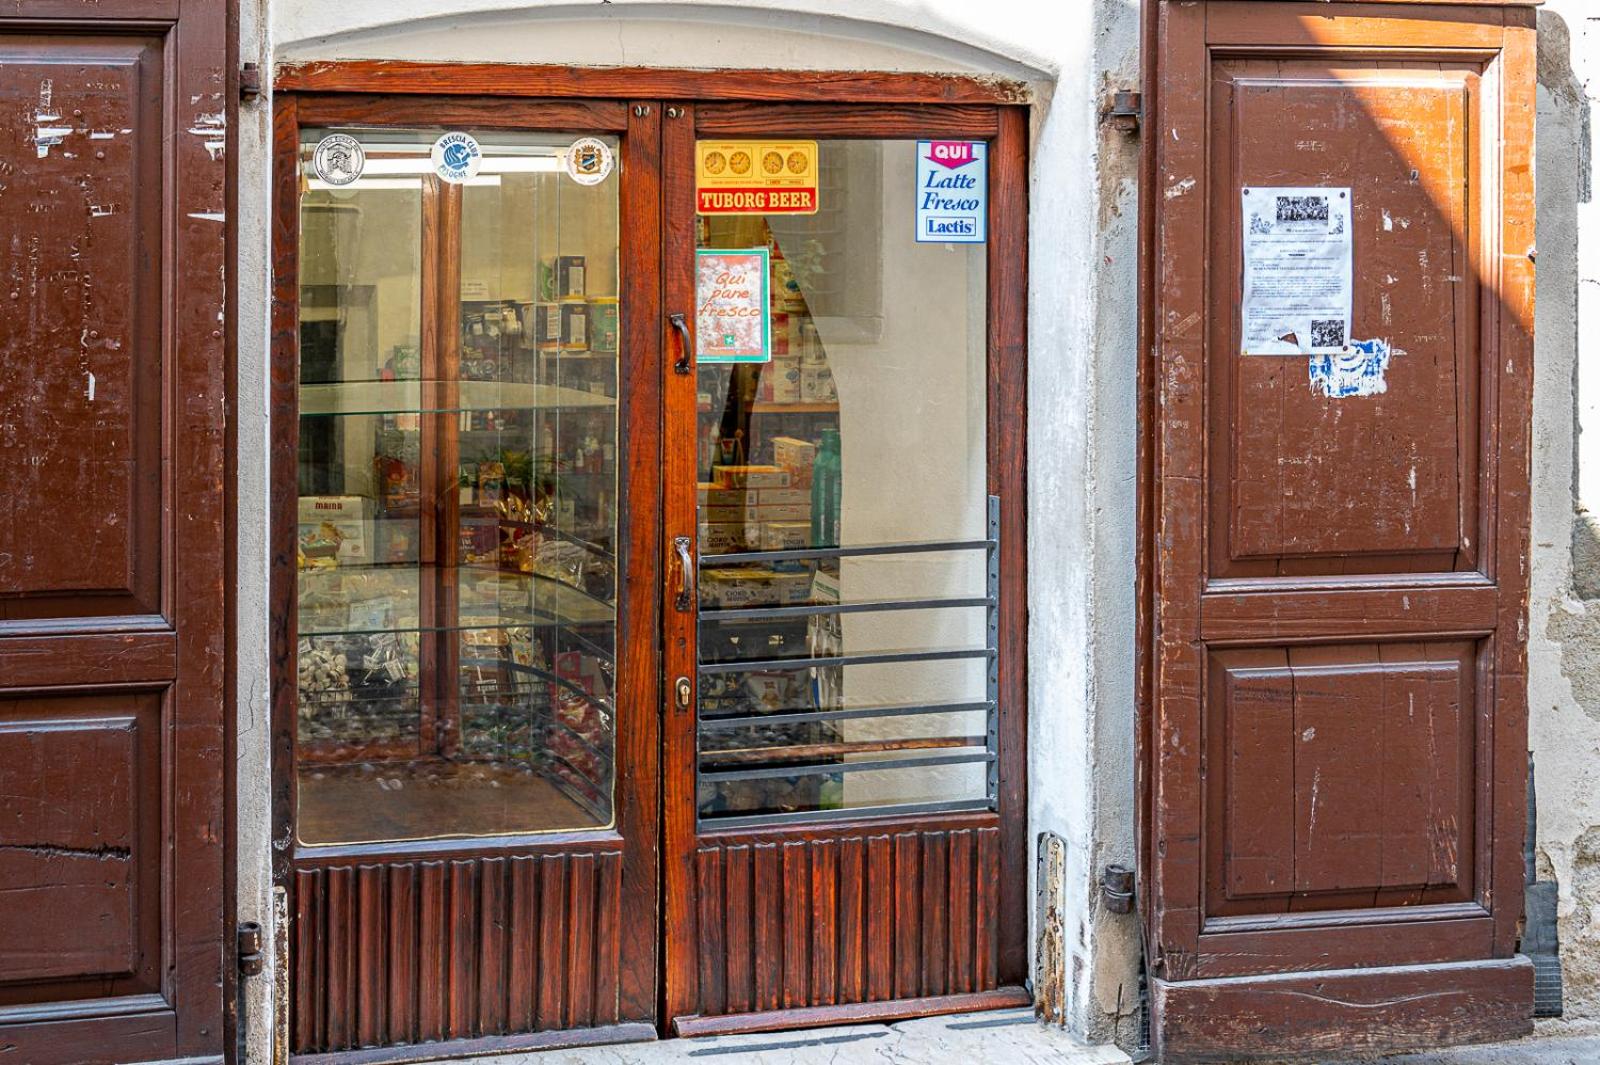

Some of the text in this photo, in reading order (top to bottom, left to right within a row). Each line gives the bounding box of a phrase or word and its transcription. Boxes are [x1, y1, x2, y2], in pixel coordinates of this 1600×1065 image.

[439, 135, 478, 157] BRESCIA CLUB
[934, 145, 968, 160] QUI
[924, 169, 977, 189] Latte
[701, 192, 812, 209] TUBORG BEER
[920, 191, 980, 211] Fresco
[927, 219, 973, 234] Lactis
[715, 271, 747, 288] Qui
[707, 288, 750, 303] pane
[698, 302, 761, 317] fresco
